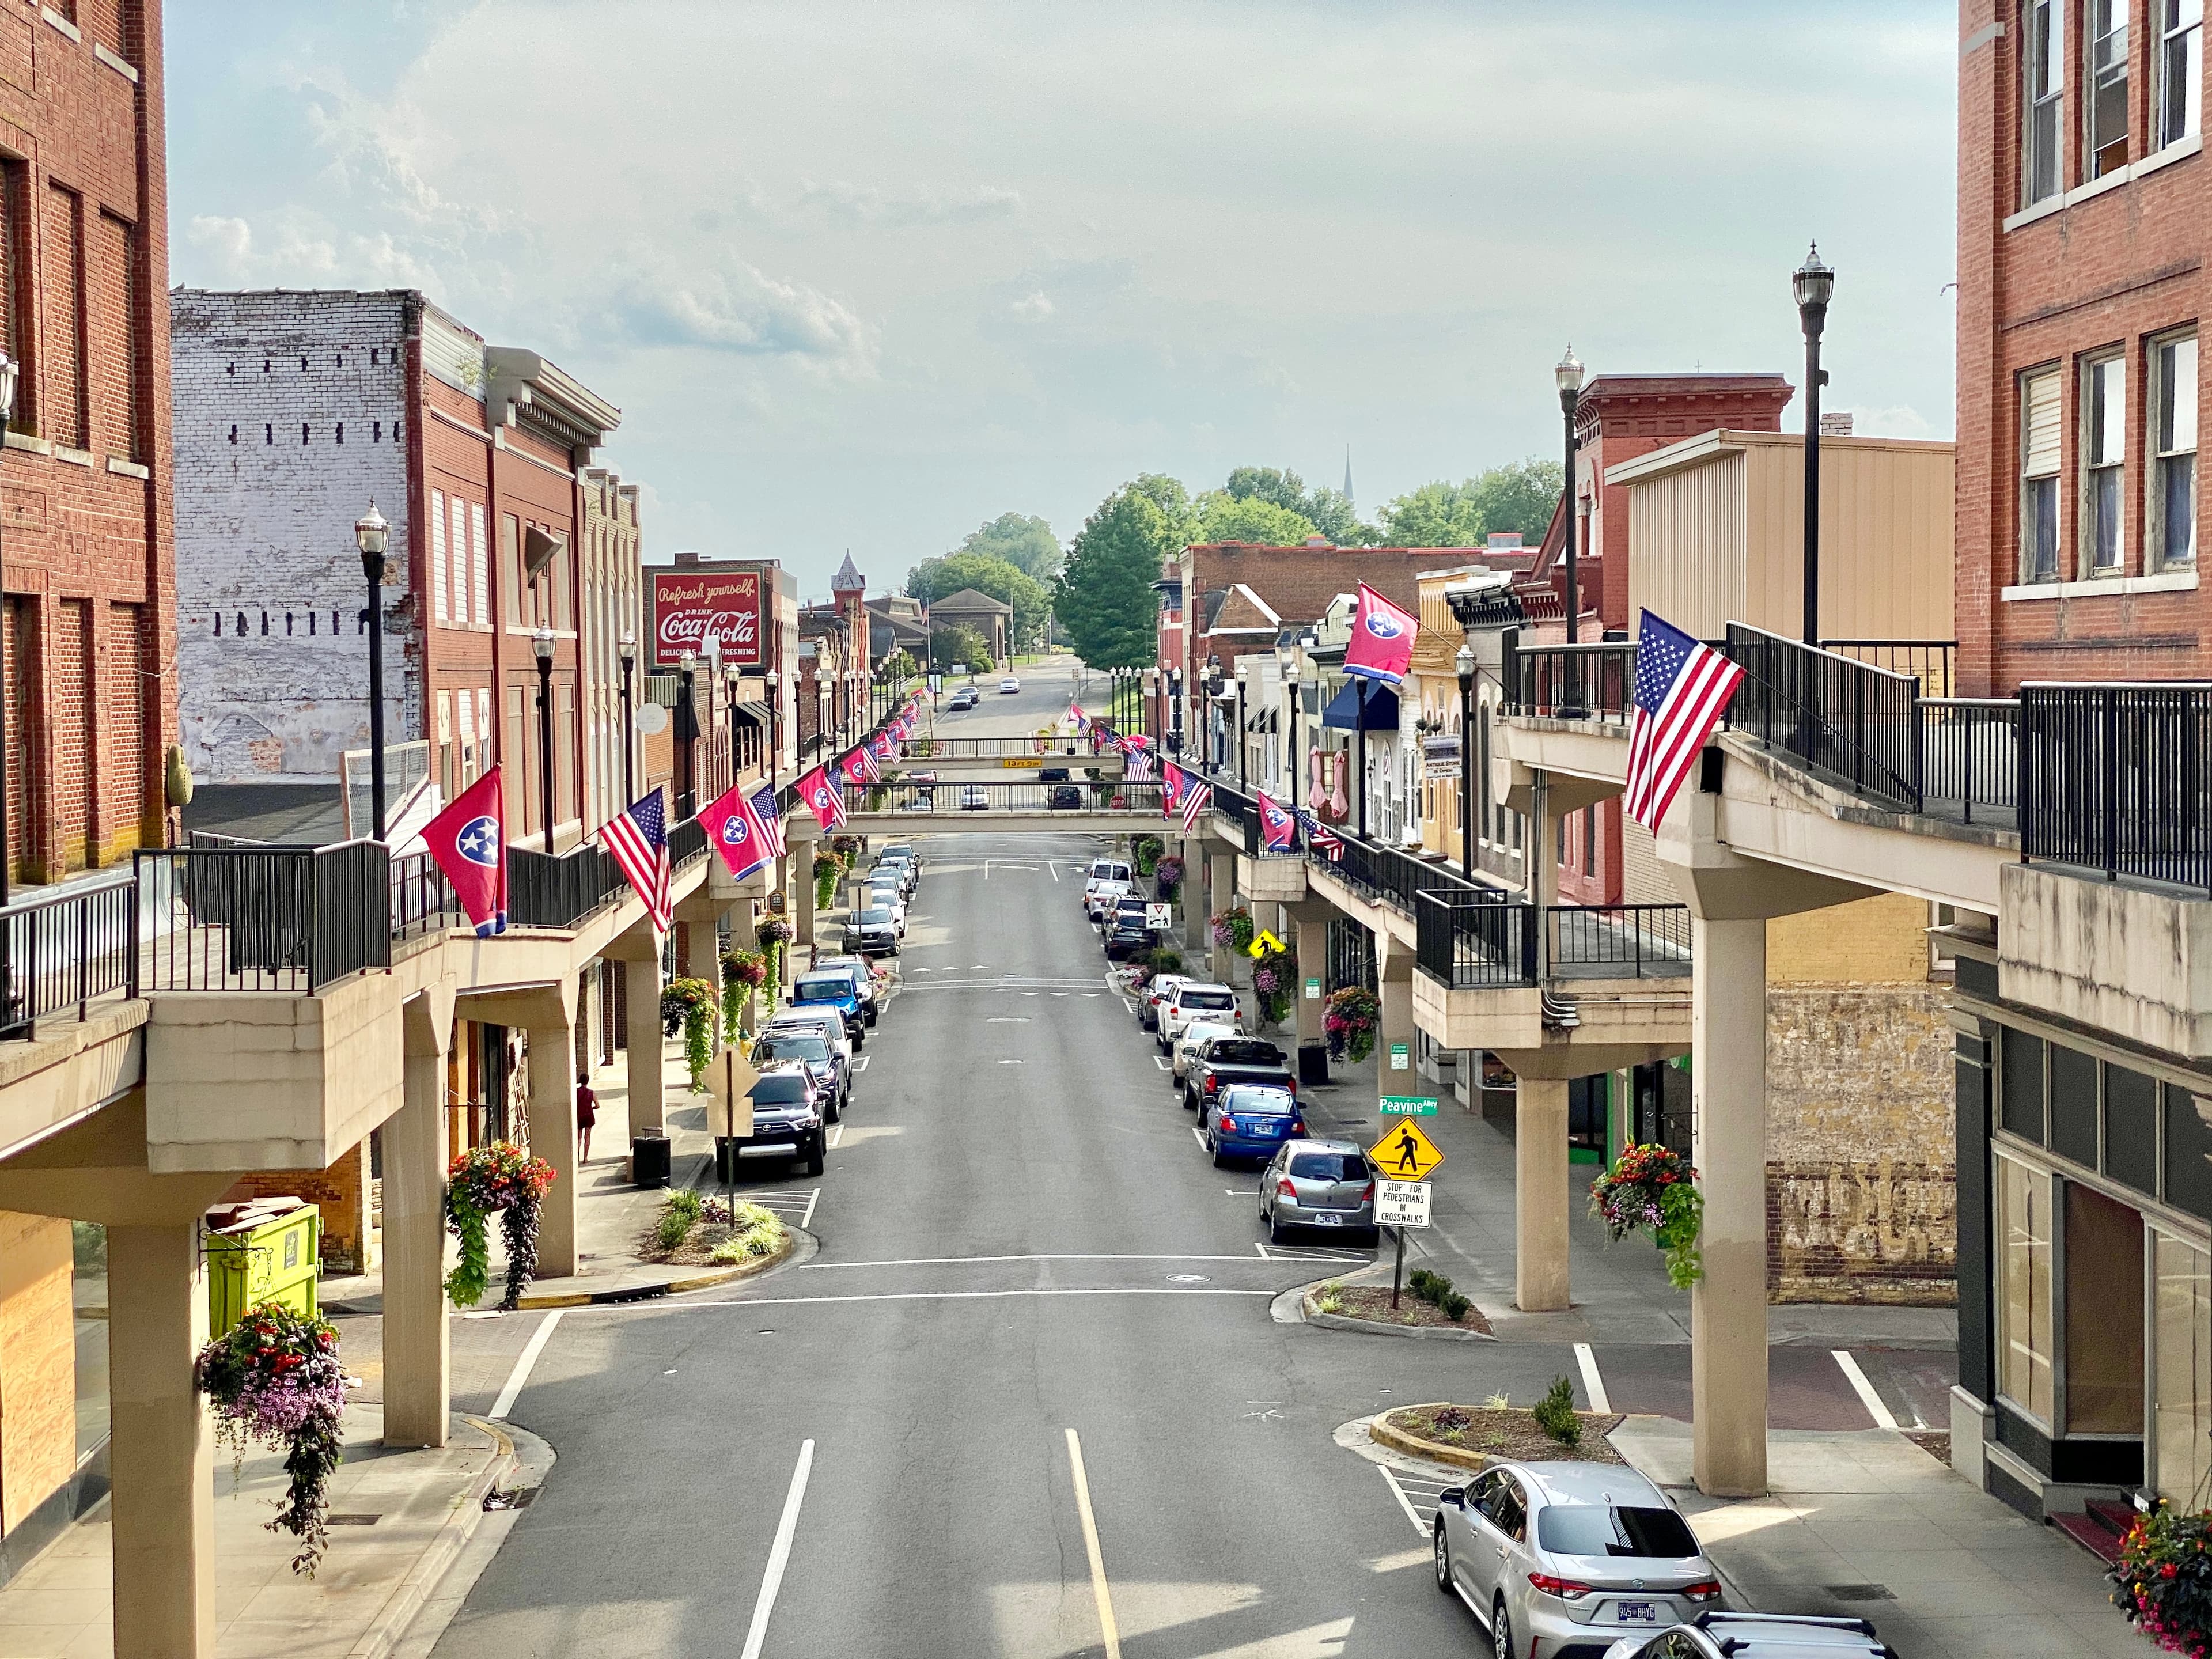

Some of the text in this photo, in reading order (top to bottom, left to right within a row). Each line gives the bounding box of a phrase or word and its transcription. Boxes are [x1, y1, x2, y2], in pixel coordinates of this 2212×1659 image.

[658, 578, 755, 605] Refresh yourself
[660, 611, 758, 643] Coca-Cola
[1380, 1098, 1438, 1112] Peavine Alley
[1387, 1183, 1422, 1193] STOP FOR
[1382, 1192, 1424, 1203] PEDESTRIANS
[1400, 1204, 1406, 1212] IN
[1381, 1213, 1423, 1224] CROSSWALKS
[1619, 1607, 1632, 1617] 945
